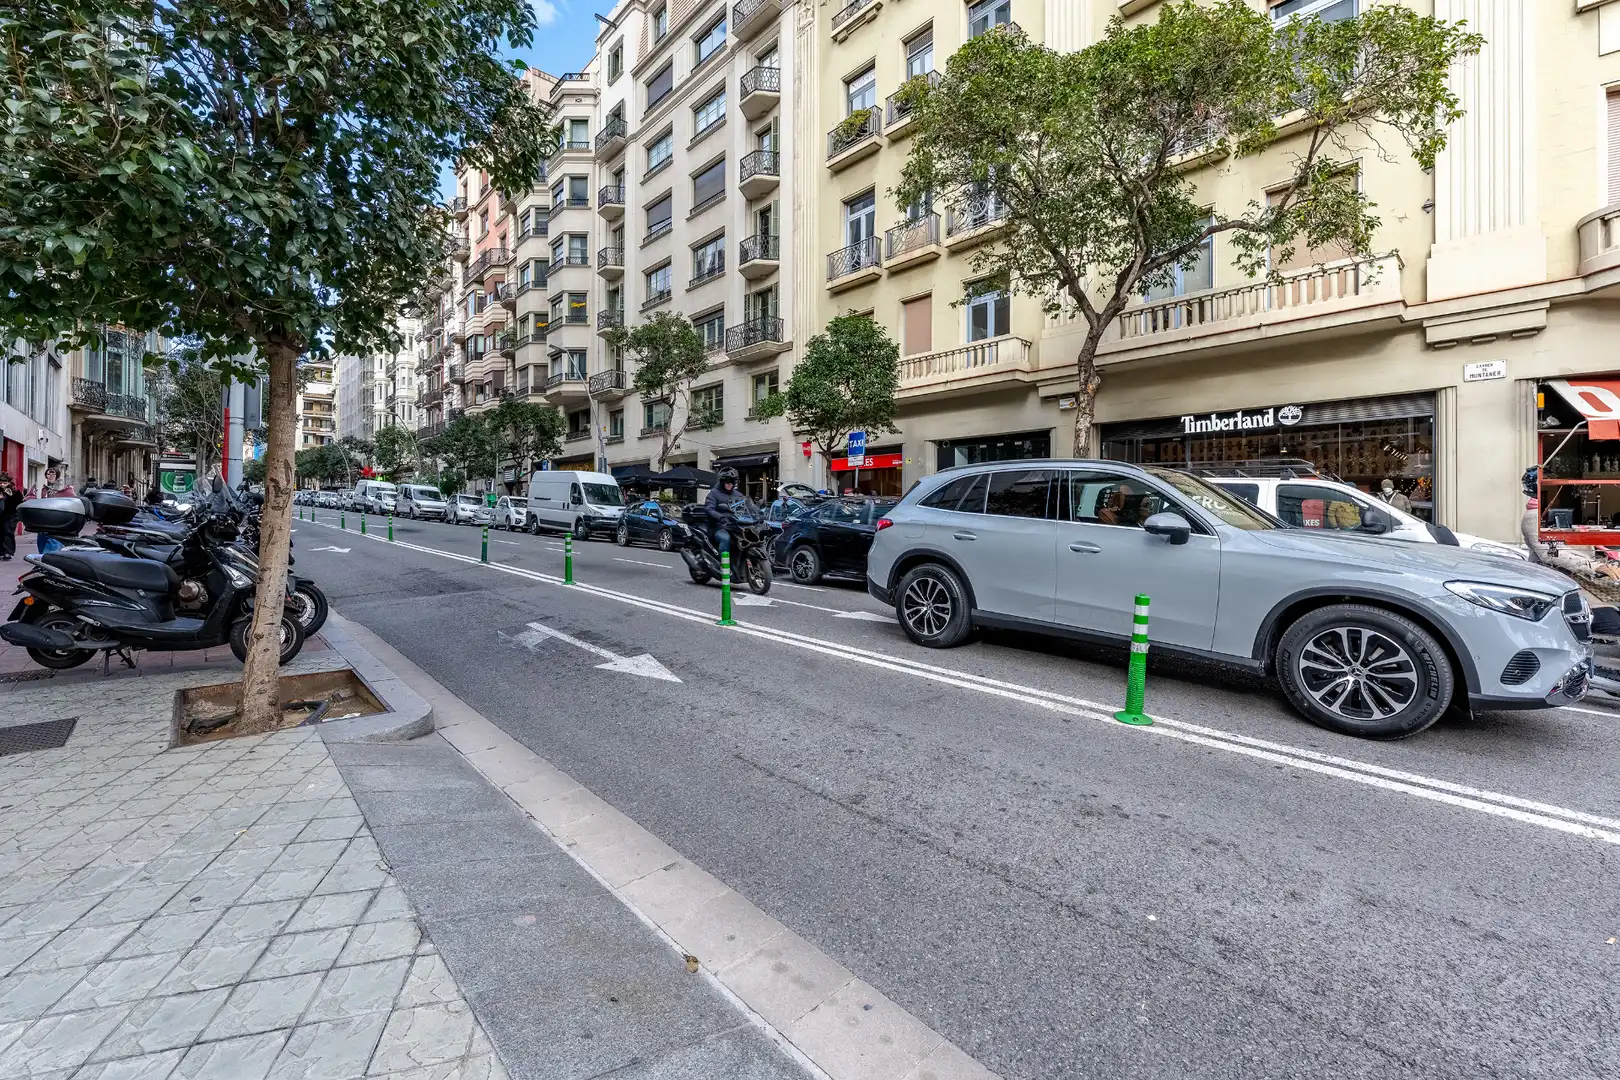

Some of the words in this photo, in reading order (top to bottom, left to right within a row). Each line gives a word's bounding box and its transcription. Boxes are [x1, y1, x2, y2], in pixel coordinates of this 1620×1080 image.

[1470, 371, 1501, 379] MUNTANER
[1181, 408, 1274, 433] Timberland
[849, 439, 864, 448] TAXI
[1420, 651, 1438, 699] MICHELIN
